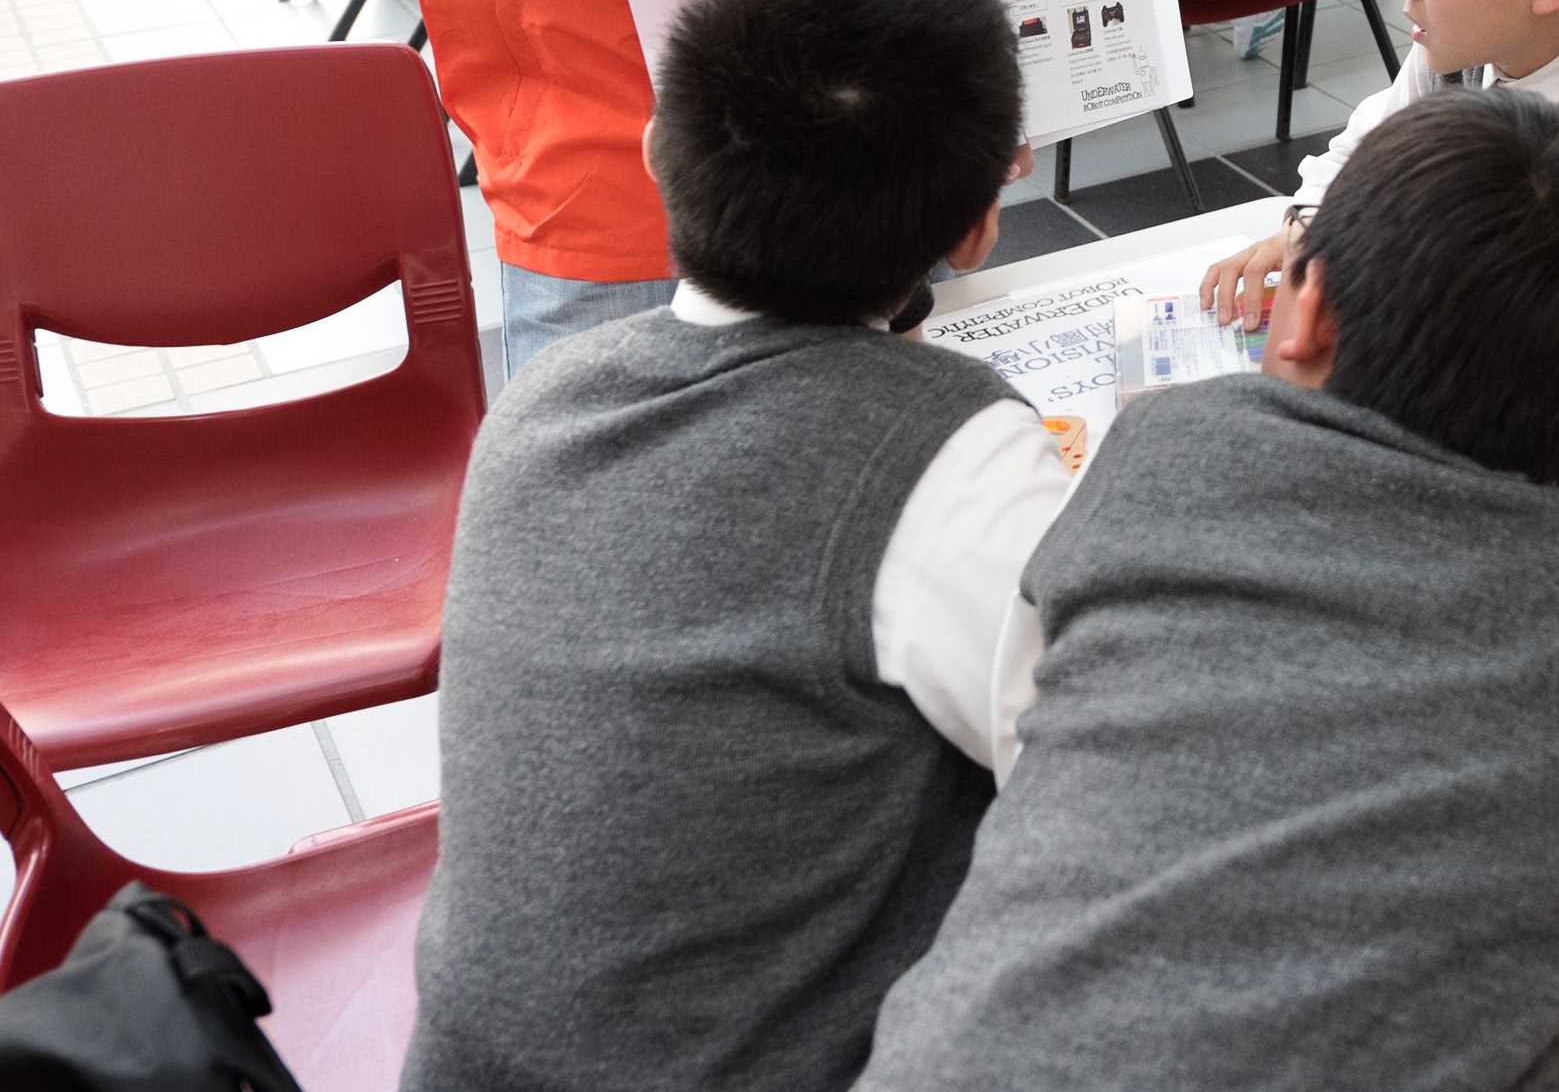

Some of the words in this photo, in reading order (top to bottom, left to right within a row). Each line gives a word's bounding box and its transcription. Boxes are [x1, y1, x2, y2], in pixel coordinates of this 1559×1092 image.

[1081, 82, 1132, 101] UNDERWATER
[1083, 101, 1103, 112] ROBOT
[1104, 91, 1143, 106] COMPETITION
